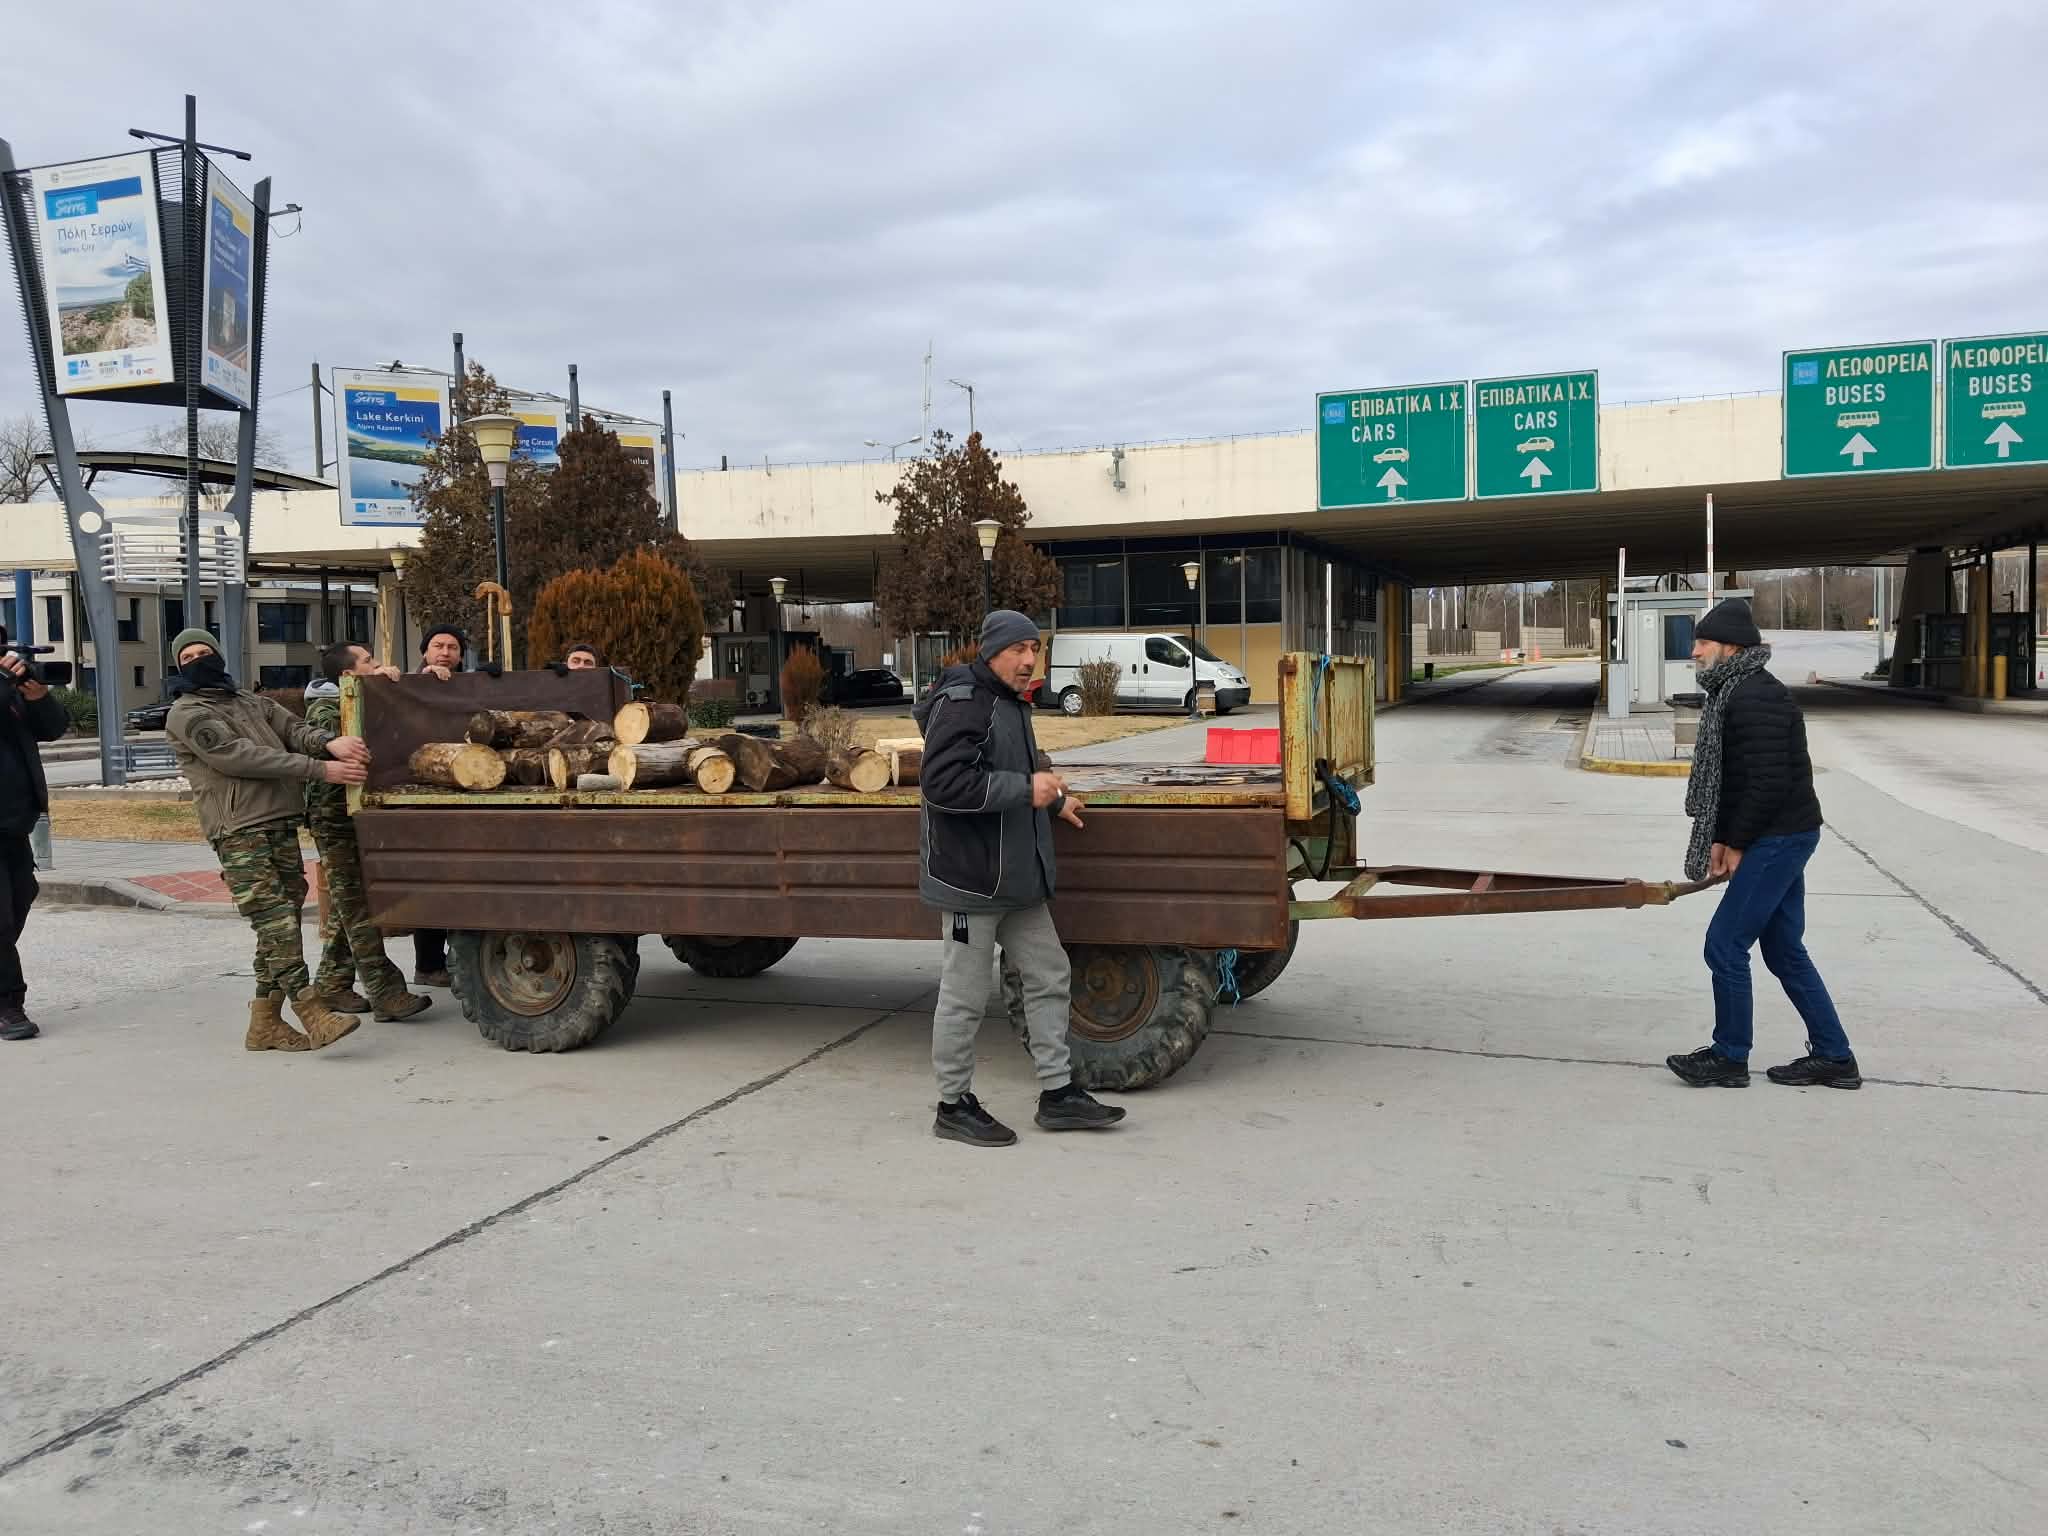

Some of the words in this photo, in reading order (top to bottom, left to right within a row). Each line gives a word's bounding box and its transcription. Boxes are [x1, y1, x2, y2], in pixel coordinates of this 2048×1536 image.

[57, 226, 87, 240] Πόλη
[90, 219, 133, 237] Σερρών
[1826, 352, 1929, 378] ΛΕΩΦΟΡΕΙΑ
[1480, 383, 1564, 408] ΕΠΙΒΑΤΙΚΑ
[1826, 383, 1886, 406] BUSES
[1969, 373, 2032, 397] BUSES
[356, 410, 381, 421] Lake
[385, 412, 424, 423] Kerkini
[1351, 394, 1432, 418] ΕΠΙΒΑΤΙΚΑ
[1514, 410, 1558, 431] CARS
[1351, 423, 1396, 443] CARS
